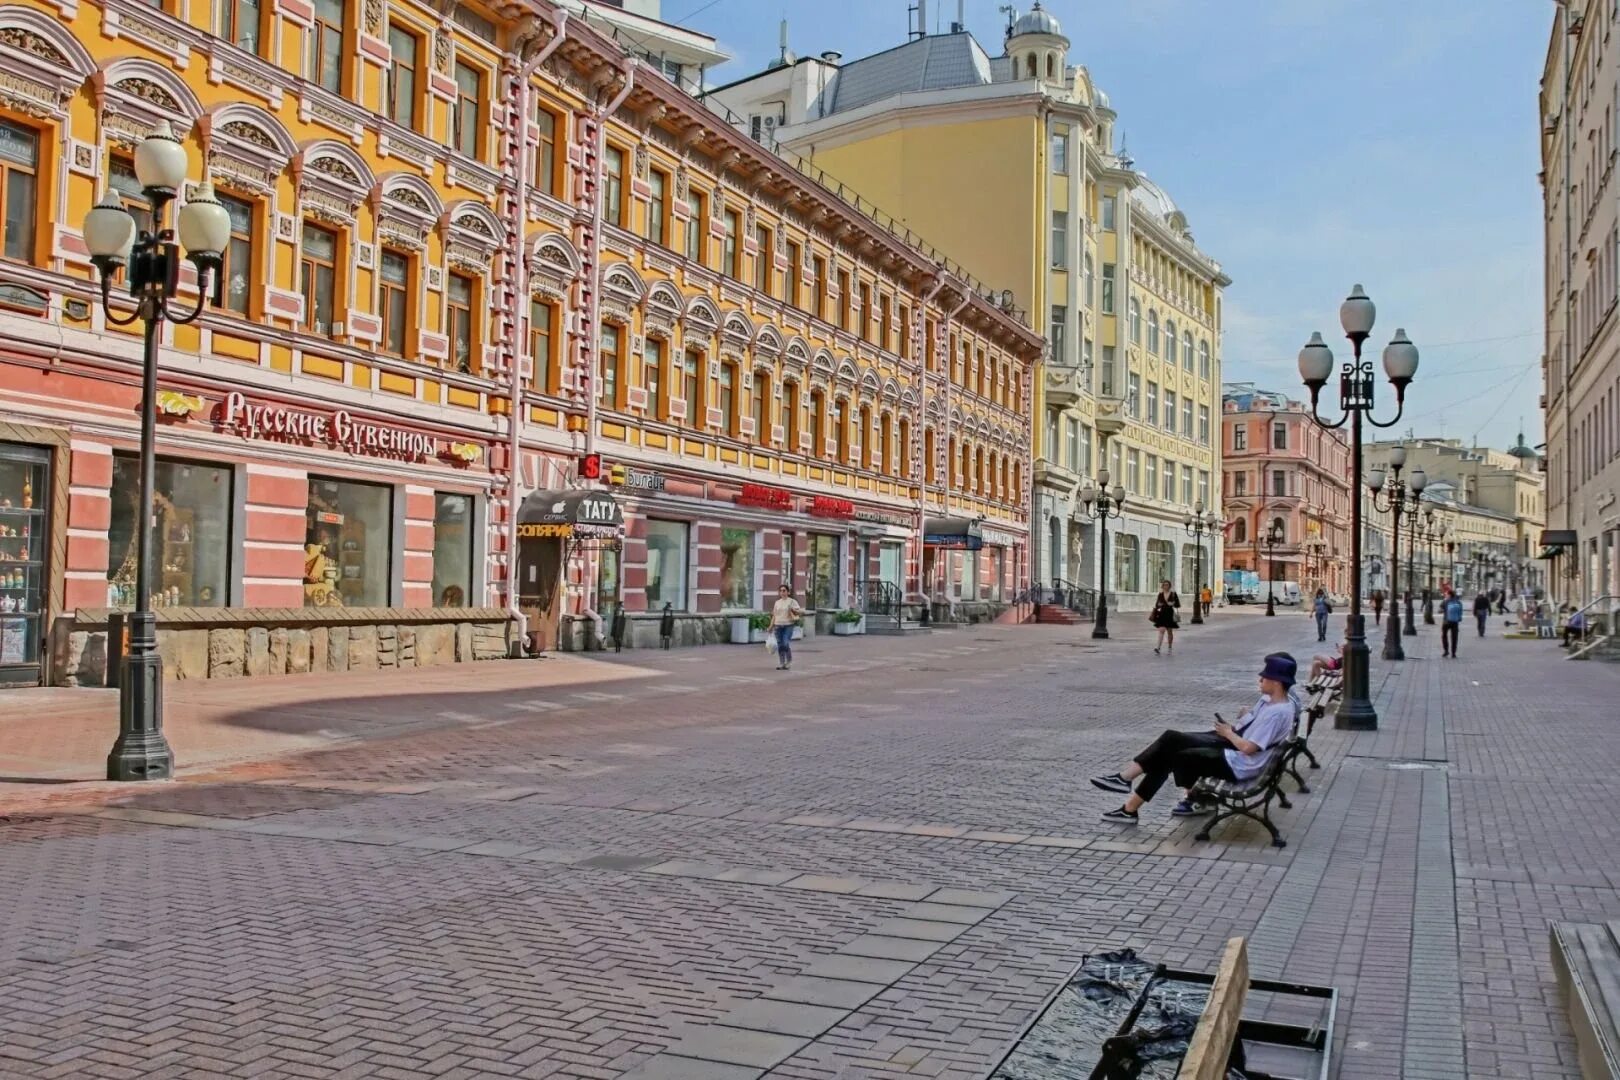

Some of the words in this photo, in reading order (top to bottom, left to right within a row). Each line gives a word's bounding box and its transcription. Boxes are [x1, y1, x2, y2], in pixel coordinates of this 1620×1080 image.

[225, 391, 325, 438] Русские
[585, 456, 598, 478] $
[628, 468, 665, 490] Билайн
[583, 499, 616, 520] ТАТУ
